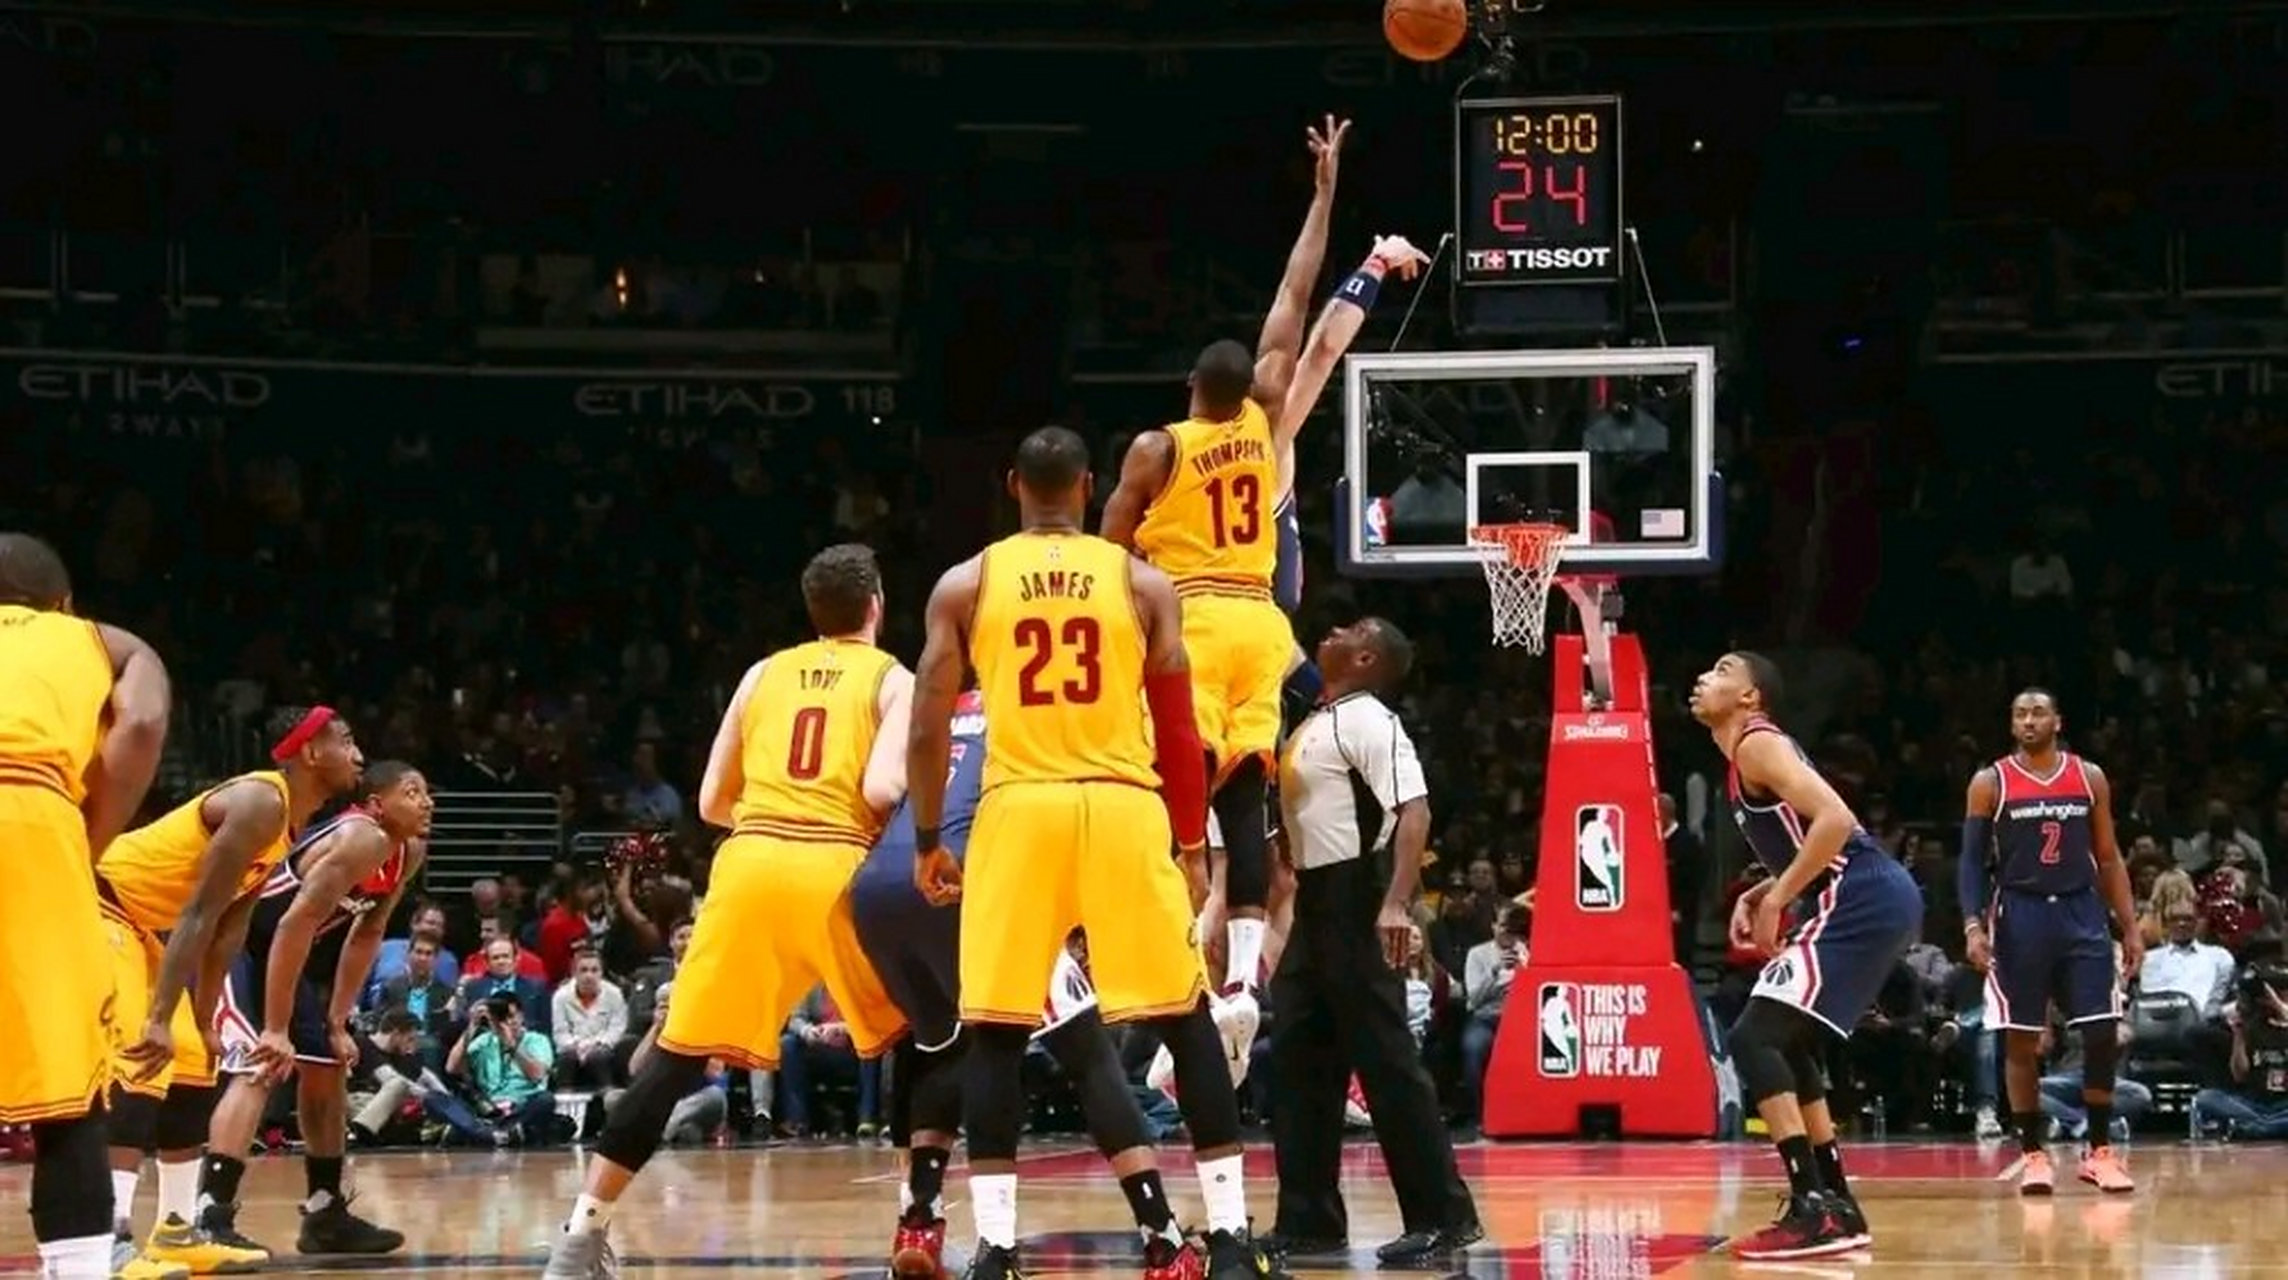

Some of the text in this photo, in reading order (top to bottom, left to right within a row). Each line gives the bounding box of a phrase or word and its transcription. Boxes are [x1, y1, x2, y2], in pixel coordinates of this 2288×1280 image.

[1497, 113, 1598, 155] 12:00
[1493, 161, 1586, 232] 24
[1507, 247, 1611, 269] TISSOT
[18, 363, 272, 407] ETIHAD
[573, 383, 817, 420] ETIHAD
[1204, 473, 1260, 550] 13
[1020, 570, 1095, 602] JAMES
[1013, 616, 1102, 708] 23
[786, 706, 827, 781] 0
[2010, 801, 2089, 821] washington
[2041, 821, 2061, 864] 2
[1582, 888, 1609, 905] NBA
[1582, 984, 1646, 1015] THIS IS
[1584, 1015, 1627, 1045] WHY
[1585, 1046, 1662, 1076] WE PLAY
